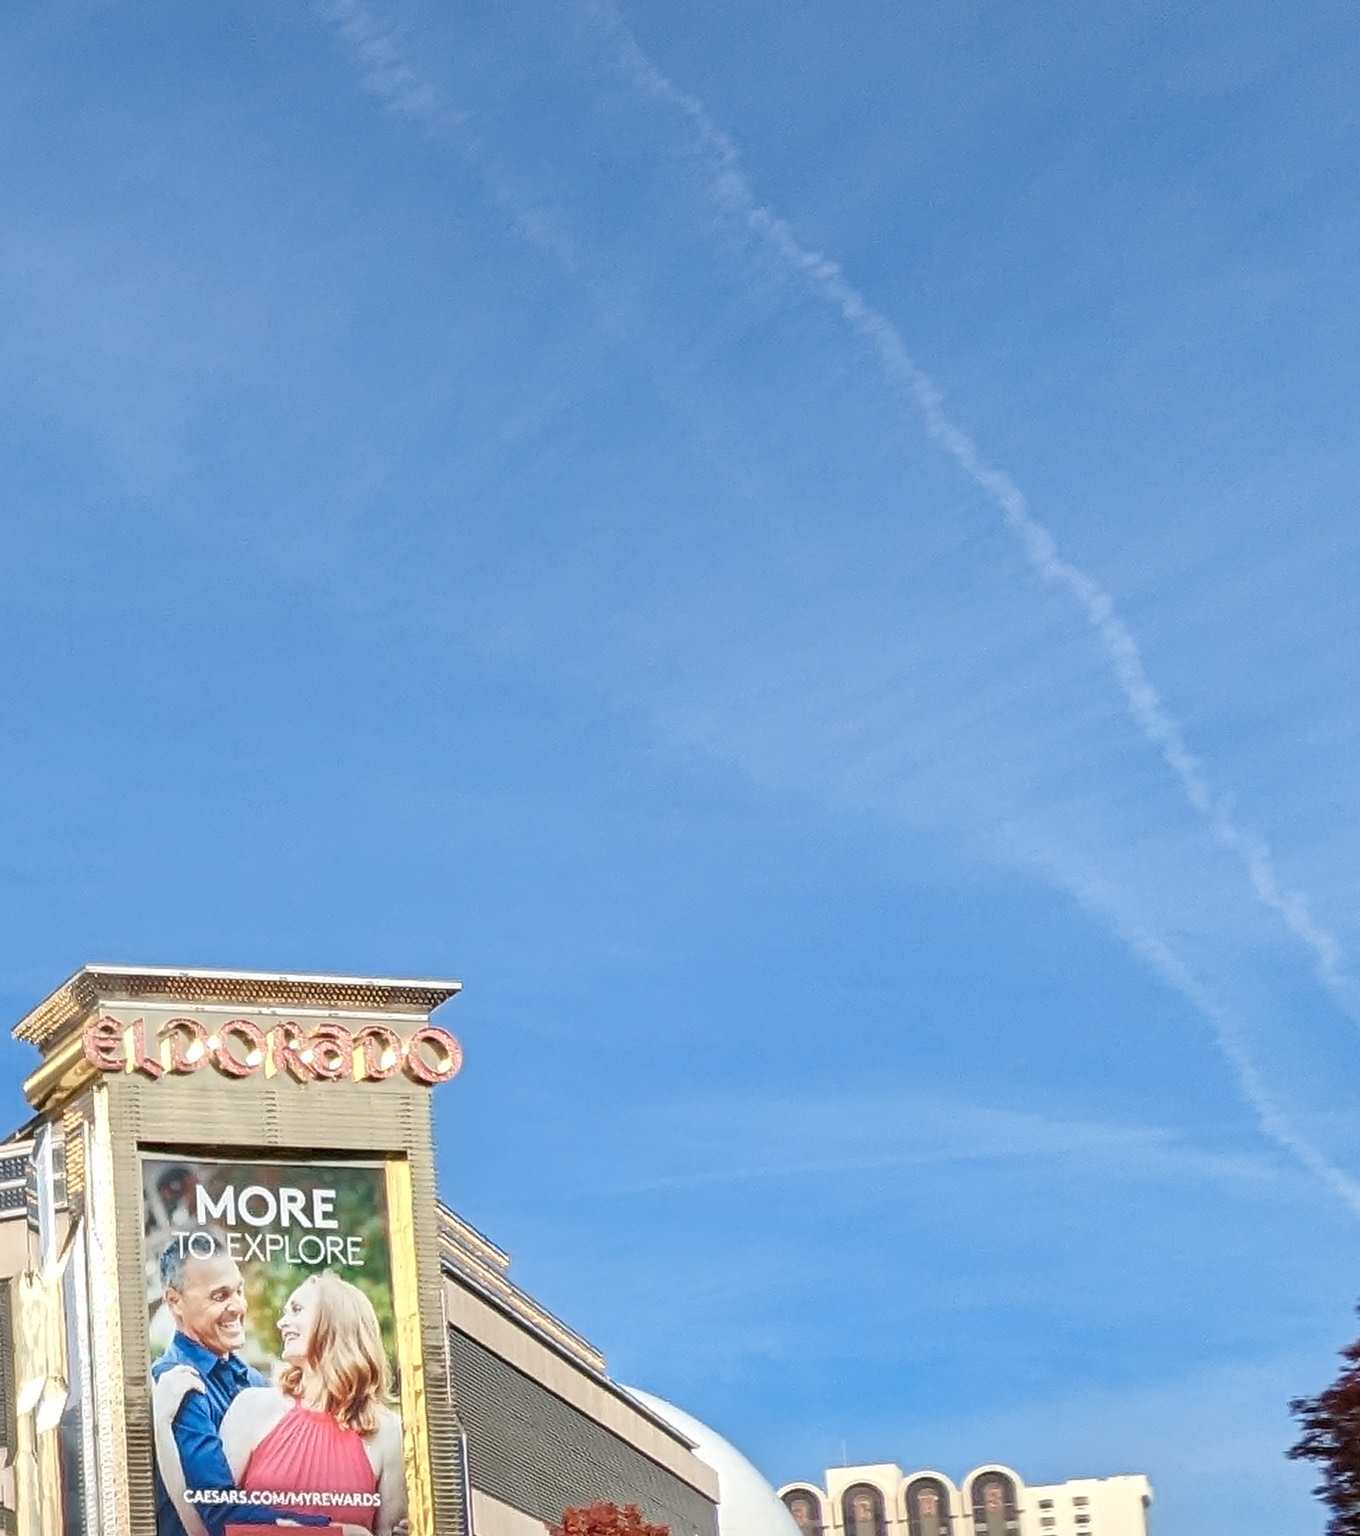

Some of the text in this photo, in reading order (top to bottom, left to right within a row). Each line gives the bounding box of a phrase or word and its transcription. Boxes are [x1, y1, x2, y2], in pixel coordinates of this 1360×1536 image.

[196, 1184, 338, 1229] MORE
[172, 1231, 365, 1265] TO EXPLORE
[183, 1489, 381, 1507] CAESARS.COM/MYREWARDS
